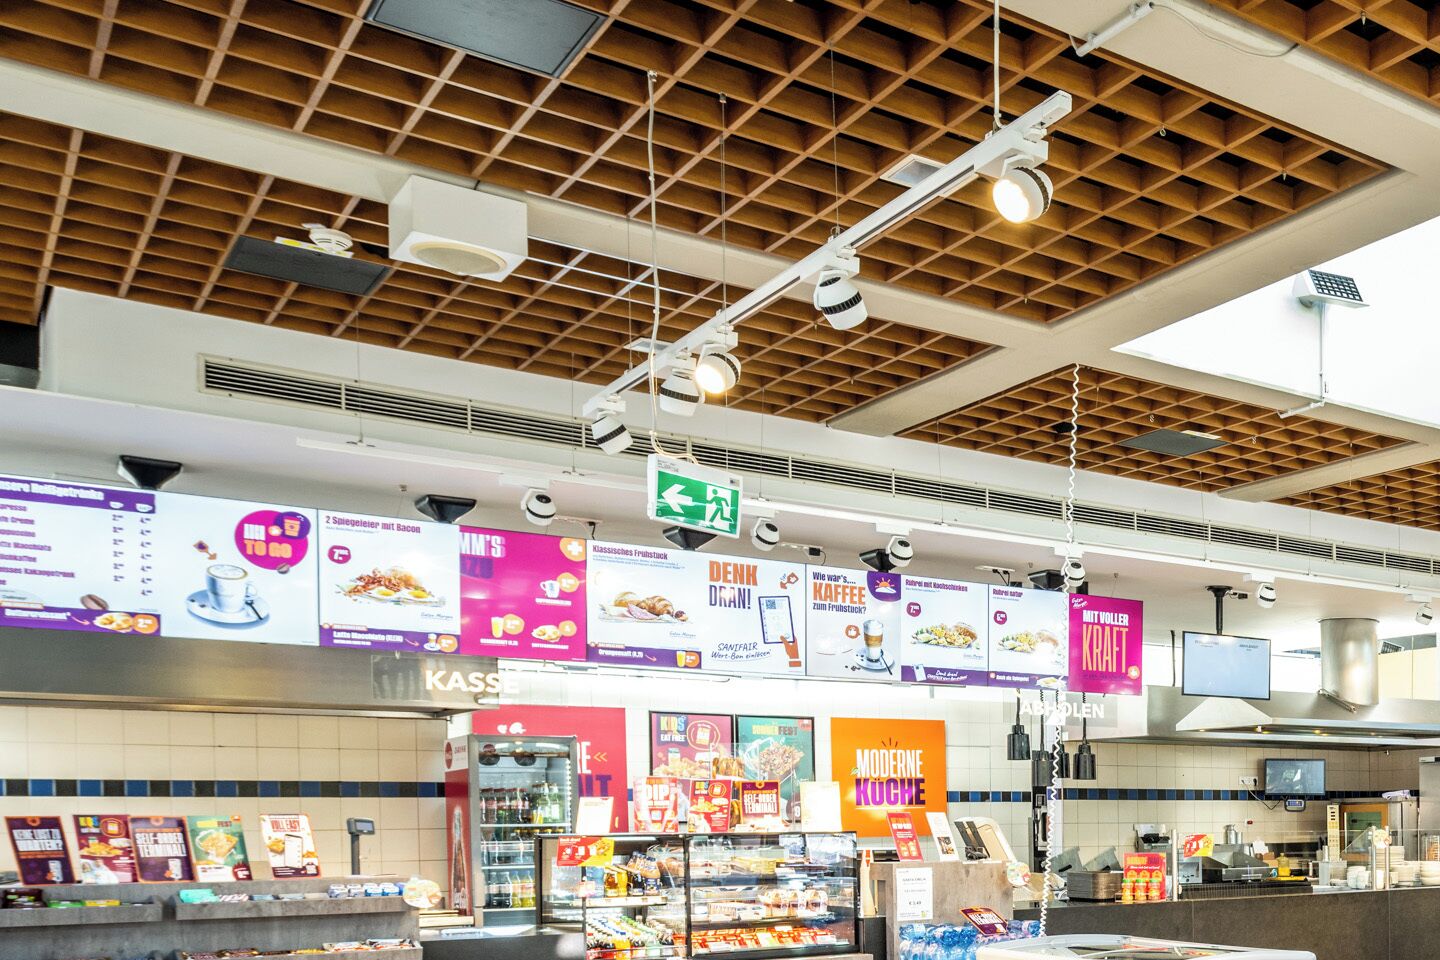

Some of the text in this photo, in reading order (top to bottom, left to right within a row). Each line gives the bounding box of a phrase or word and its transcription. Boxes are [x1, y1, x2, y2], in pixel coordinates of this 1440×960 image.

[325, 515, 331, 525] 2
[332, 516, 380, 529] Spiegeleier
[381, 522, 395, 531] mit
[396, 523, 421, 534] Bacon
[709, 560, 758, 586] DENK
[812, 571, 826, 581] Wie
[709, 584, 751, 609] DRAN!
[813, 581, 866, 605] KAFFEE
[812, 602, 827, 611] zum
[1082, 610, 1129, 626] MIT VOLLER
[717, 641, 758, 652] SANIFAIR
[1082, 623, 1129, 673] KRAFT
[425, 670, 519, 693] KASSE
[1018, 699, 1105, 719] ABHOLEN
[855, 748, 923, 778] MODERNE
[855, 777, 926, 806] KÜCHE
